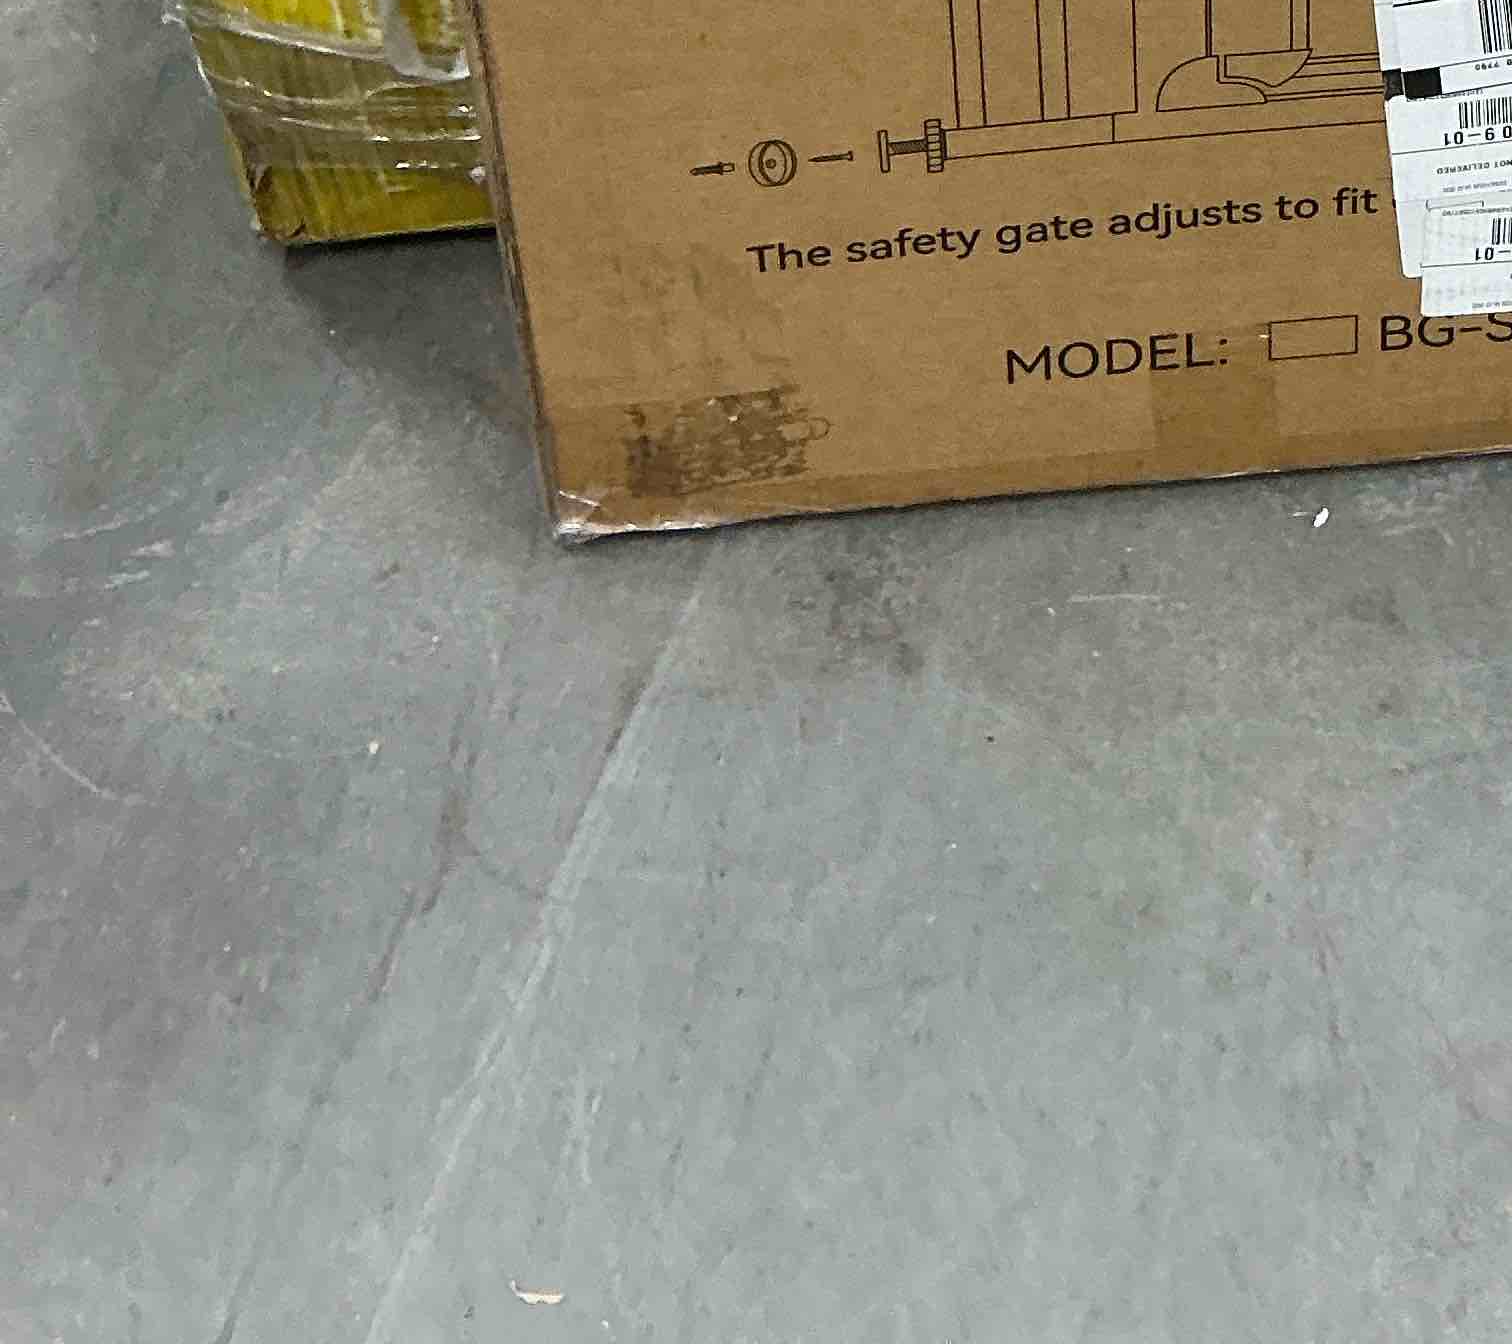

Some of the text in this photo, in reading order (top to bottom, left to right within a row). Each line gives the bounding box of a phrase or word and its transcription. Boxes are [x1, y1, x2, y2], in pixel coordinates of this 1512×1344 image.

[1435, 160, 1490, 175] DELIVERED
[746, 237, 831, 273] The
[846, 225, 978, 268] safety
[995, 212, 1094, 254] gate
[1108, 196, 1264, 244] adjusts
[1274, 194, 1319, 221] to
[1331, 185, 1377, 218] fit
[1005, 332, 1229, 386] MODEL:
